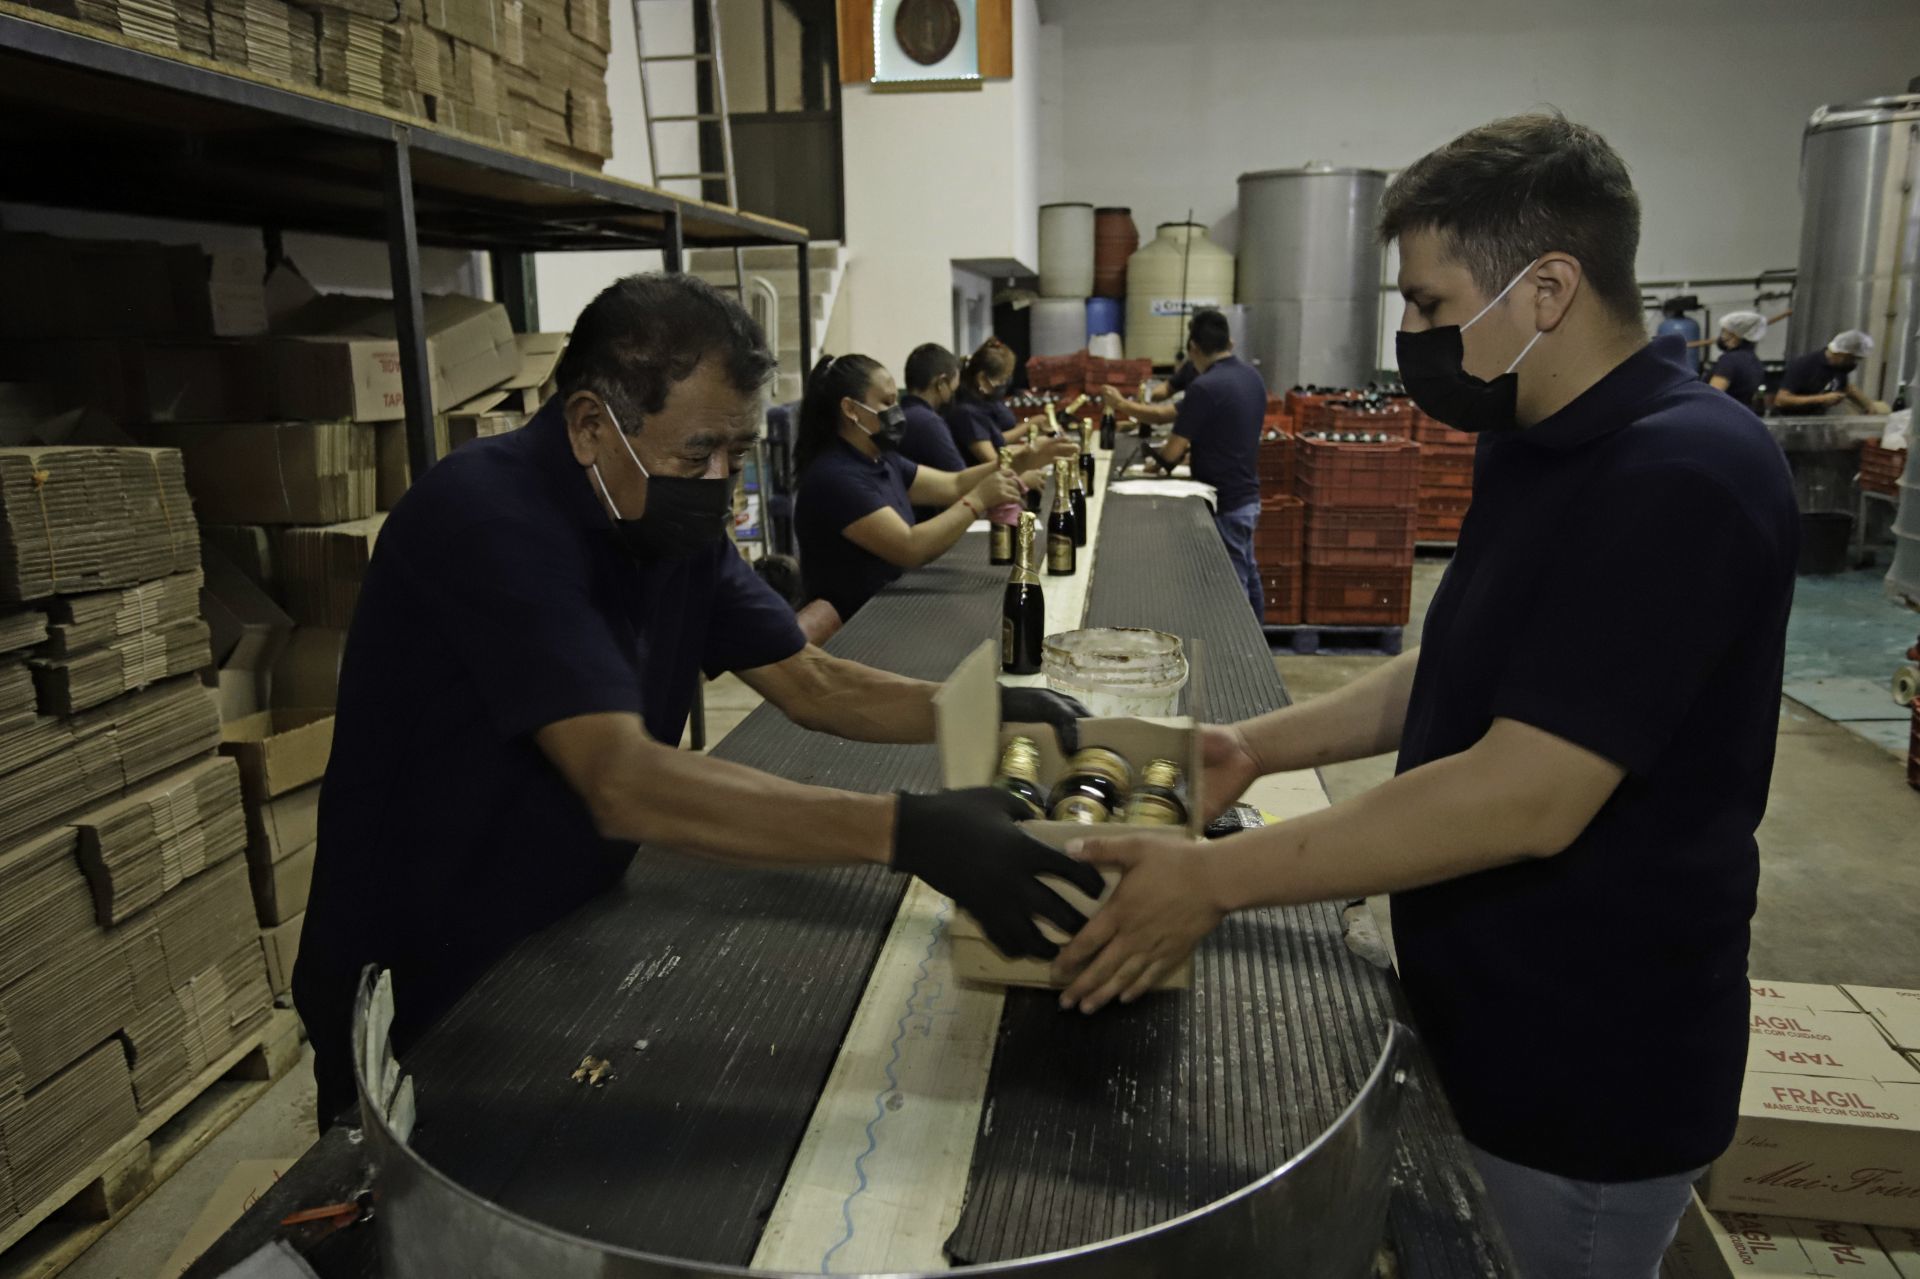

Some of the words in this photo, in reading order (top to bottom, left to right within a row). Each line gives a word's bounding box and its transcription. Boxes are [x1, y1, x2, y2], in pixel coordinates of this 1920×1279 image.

[383, 393, 404, 408] TAP
[1750, 1014, 1812, 1033] AGIL
[1766, 1049, 1844, 1067] TAPA
[1771, 1086, 1876, 1110] FRAGIL
[1763, 1101, 1820, 1115] MANEJESE
[1823, 1107, 1848, 1117] CON
[1850, 1110, 1900, 1121] CUIDADO
